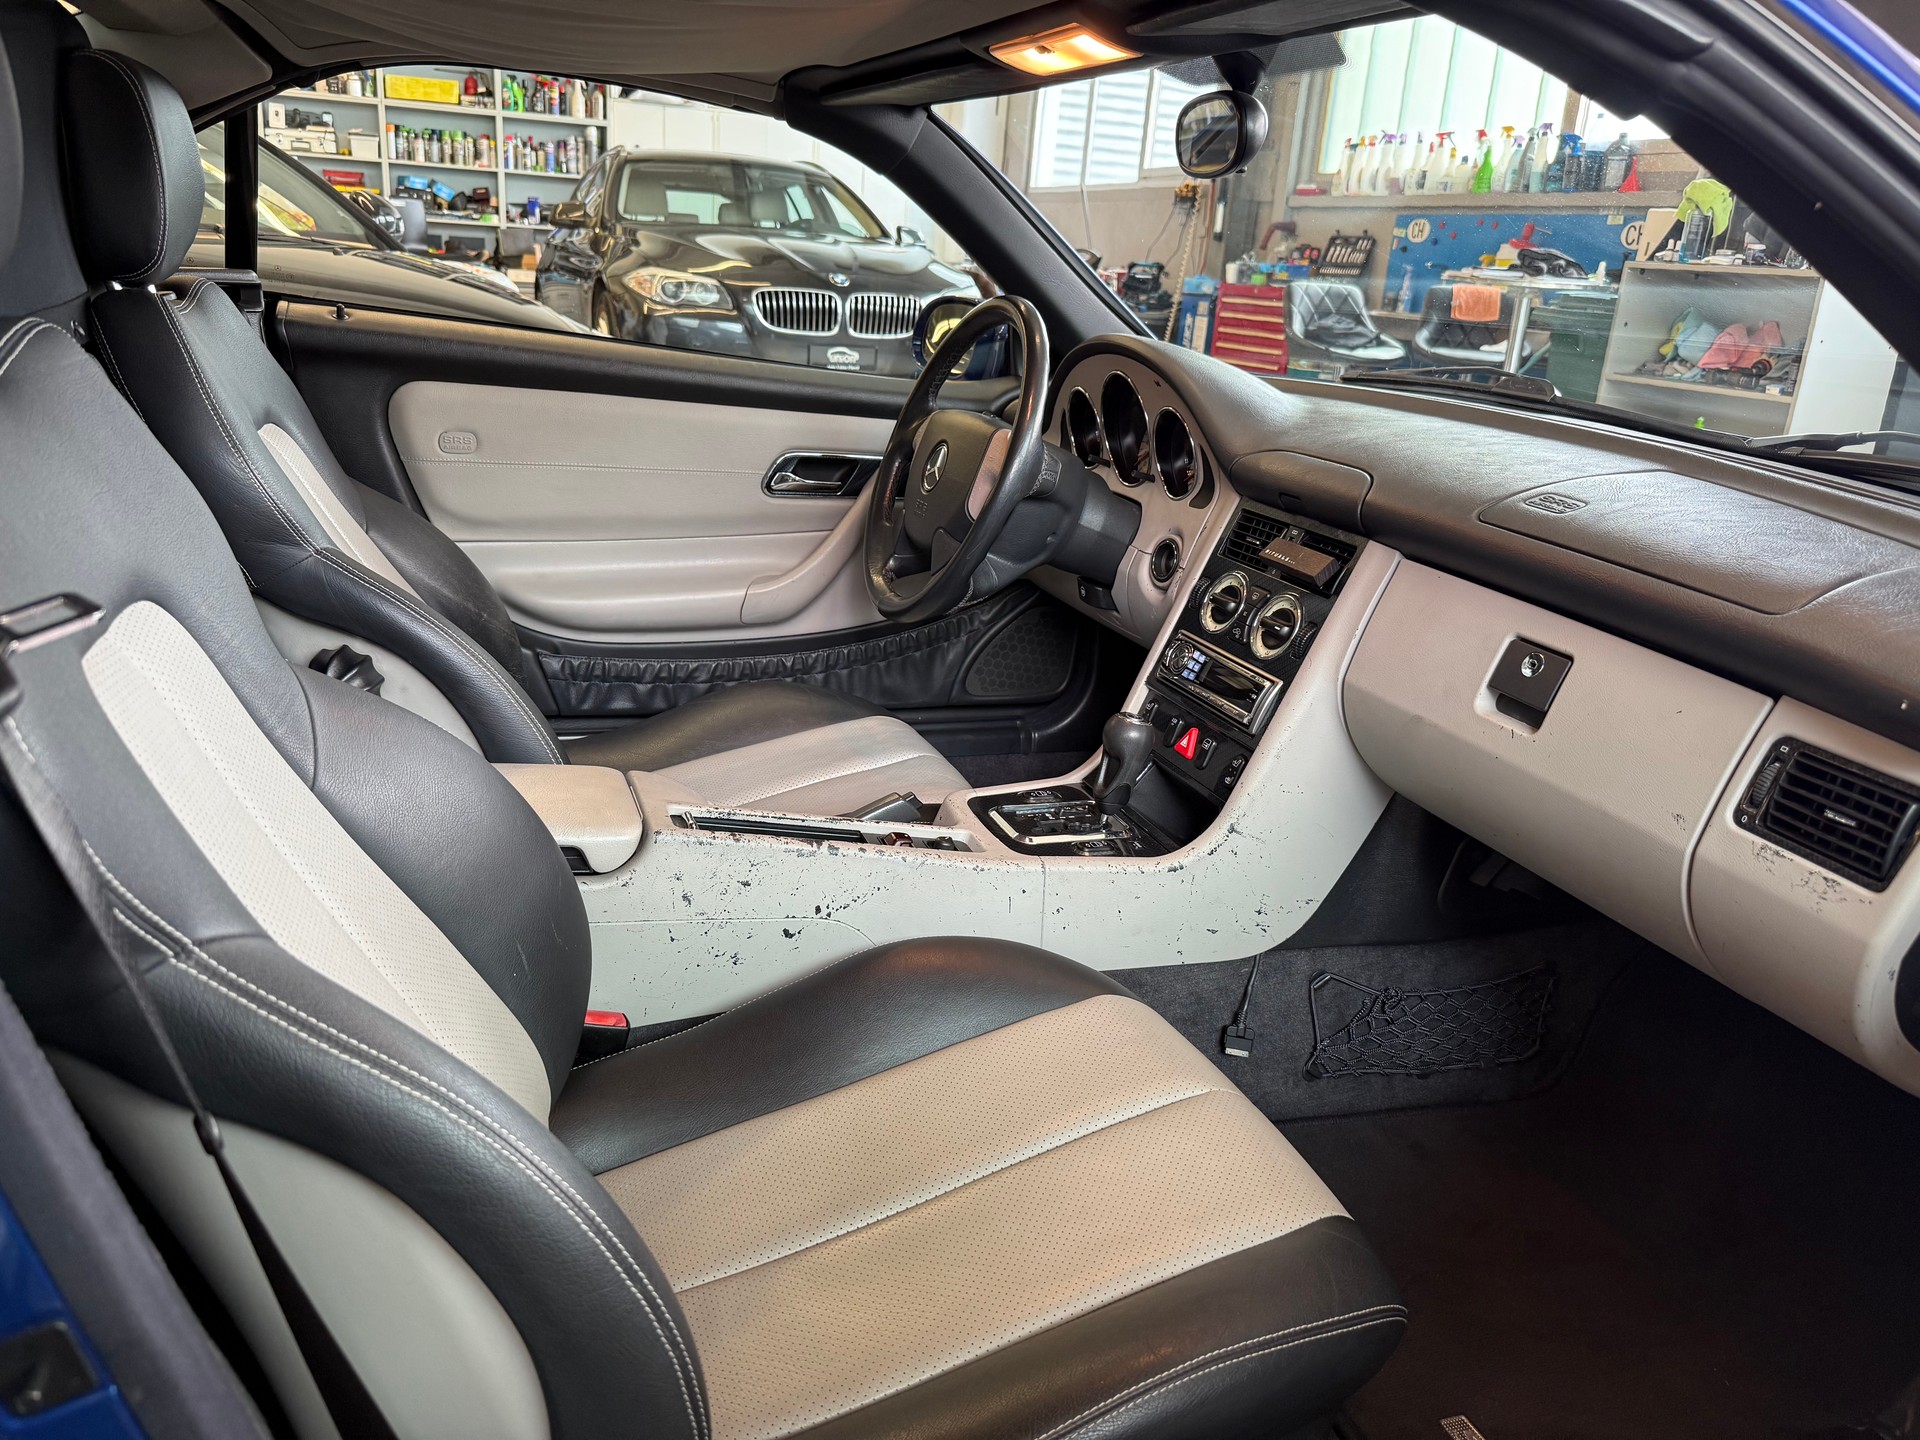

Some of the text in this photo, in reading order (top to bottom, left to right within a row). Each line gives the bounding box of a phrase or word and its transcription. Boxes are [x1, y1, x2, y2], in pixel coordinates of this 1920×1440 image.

[1411, 221, 1425, 239] CH
[442, 435, 473, 445] SRS
[1539, 495, 1580, 509] SRS
